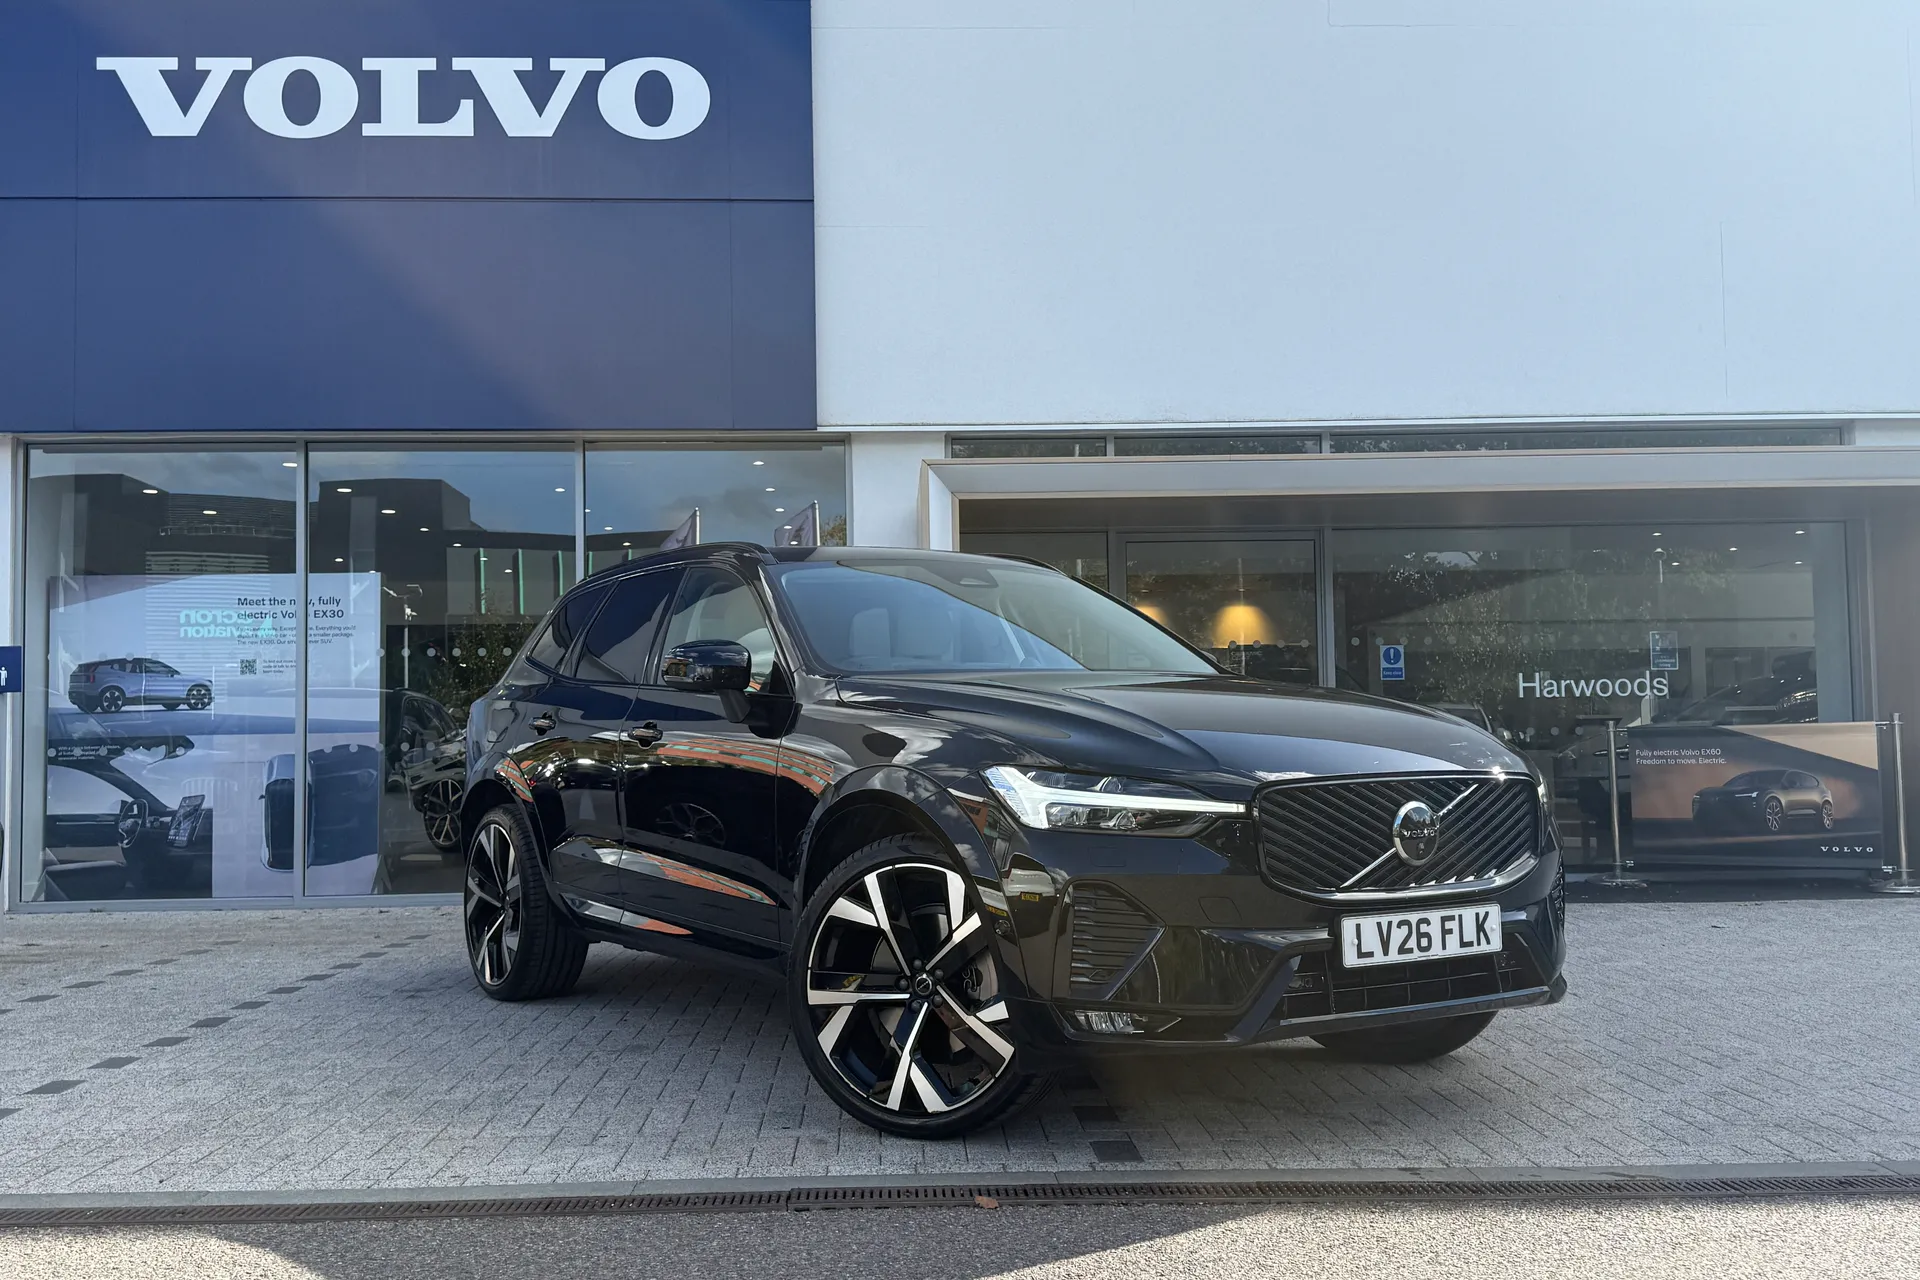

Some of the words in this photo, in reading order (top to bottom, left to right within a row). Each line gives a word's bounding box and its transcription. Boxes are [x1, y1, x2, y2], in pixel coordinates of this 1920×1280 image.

[96, 56, 711, 140] VOLVO
[237, 597, 266, 606] Meet
[269, 597, 286, 606] the
[289, 598, 315, 607] n,
[318, 596, 341, 607] fully
[237, 610, 278, 619] electric
[280, 610, 311, 619] Vol
[313, 609, 345, 619] EX30
[1518, 670, 1669, 698] Harwoods
[1635, 749, 1652, 758] Fully
[1701, 748, 1721, 756] EX60
[1698, 757, 1727, 765] Electric.
[1401, 829, 1435, 838] VOLVO
[1355, 917, 1433, 960] LV26
[1440, 911, 1492, 951] FLK
